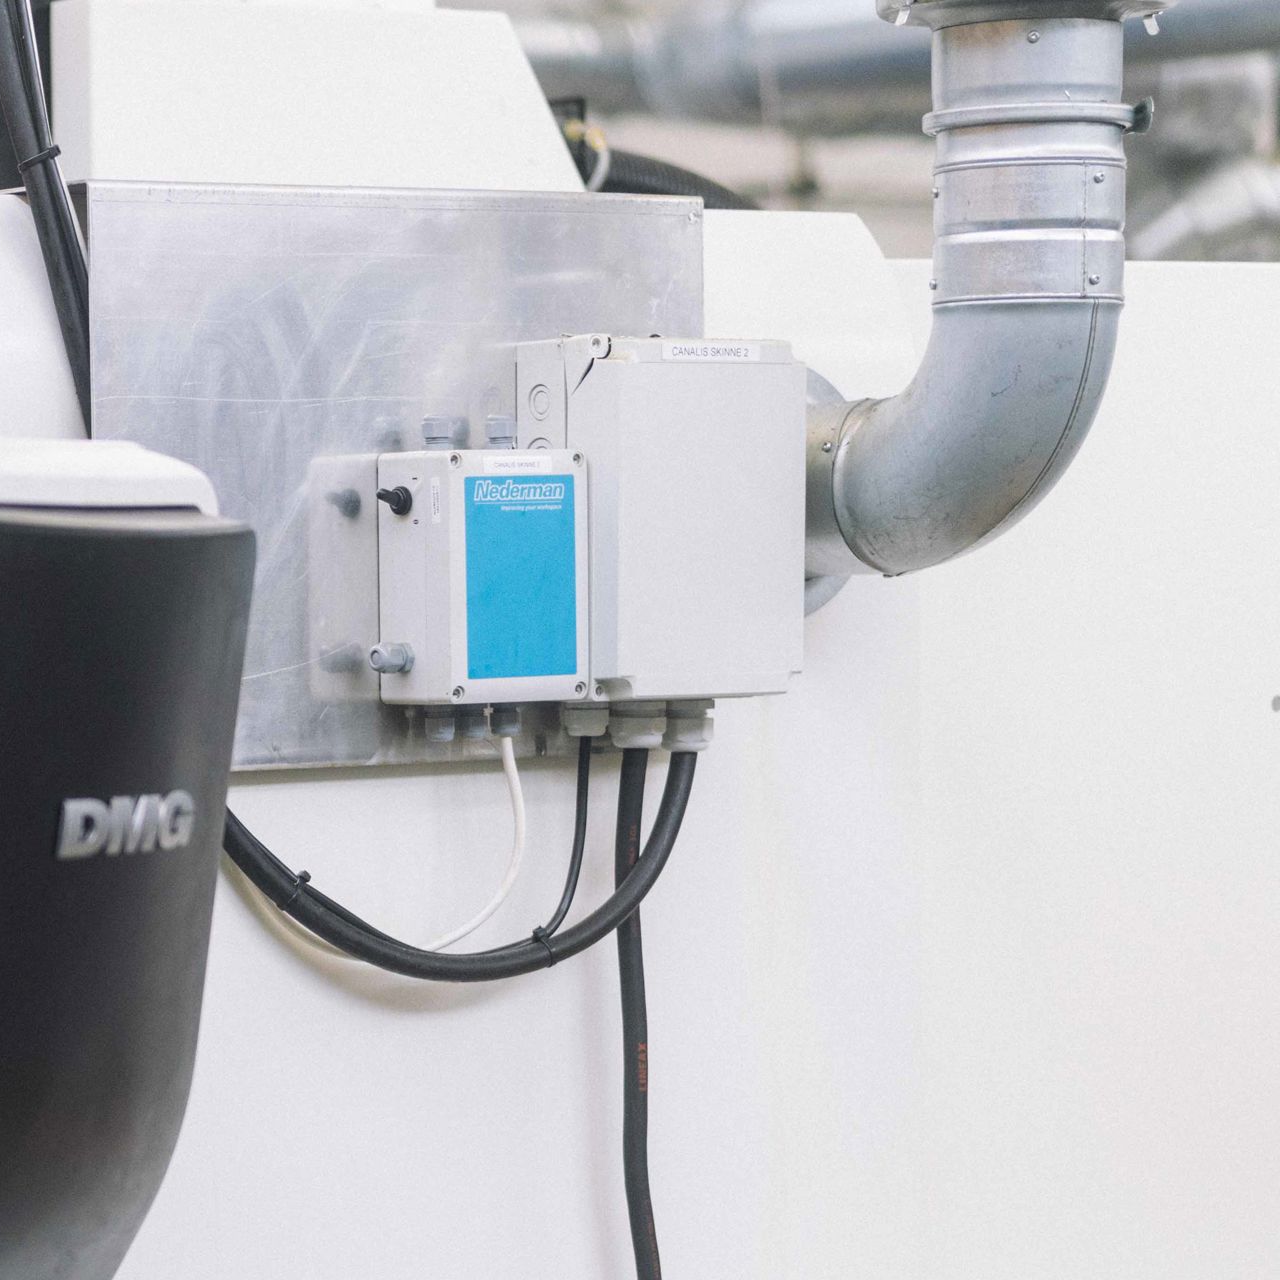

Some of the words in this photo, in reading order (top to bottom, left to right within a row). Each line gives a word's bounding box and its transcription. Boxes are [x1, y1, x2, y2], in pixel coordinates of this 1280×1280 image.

[672, 346, 708, 356] CANALIS
[710, 347, 741, 357] SKINNE
[744, 348, 749, 357] 2
[474, 480, 564, 500] Nederman
[56, 789, 194, 860] DMG
